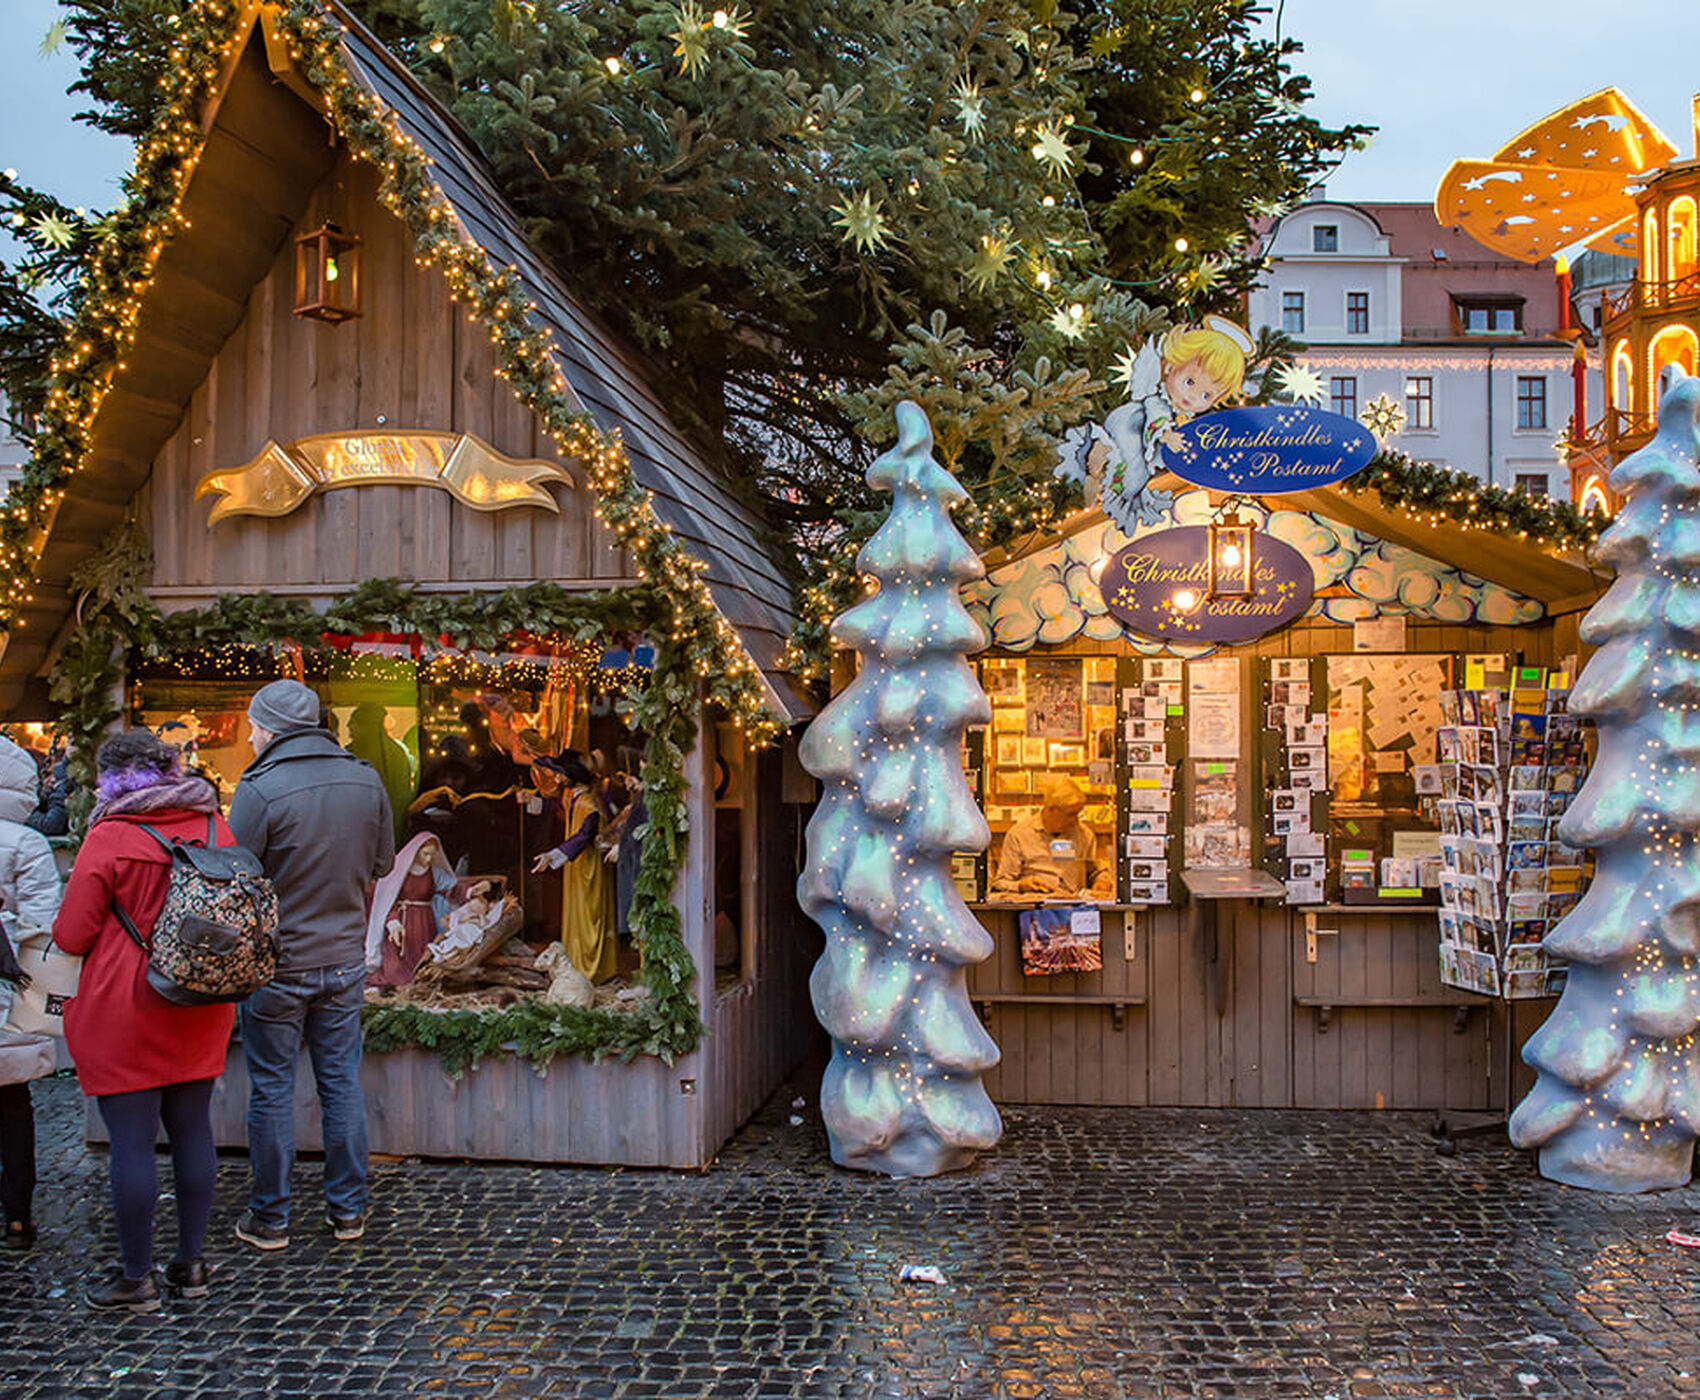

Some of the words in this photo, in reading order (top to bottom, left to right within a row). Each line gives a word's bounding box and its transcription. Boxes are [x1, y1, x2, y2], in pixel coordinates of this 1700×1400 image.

[345, 437, 403, 456] Gloria
[1195, 423, 1332, 450] Christkindles
[1249, 452, 1343, 477] Postamt
[1122, 553, 1276, 583] Christknles
